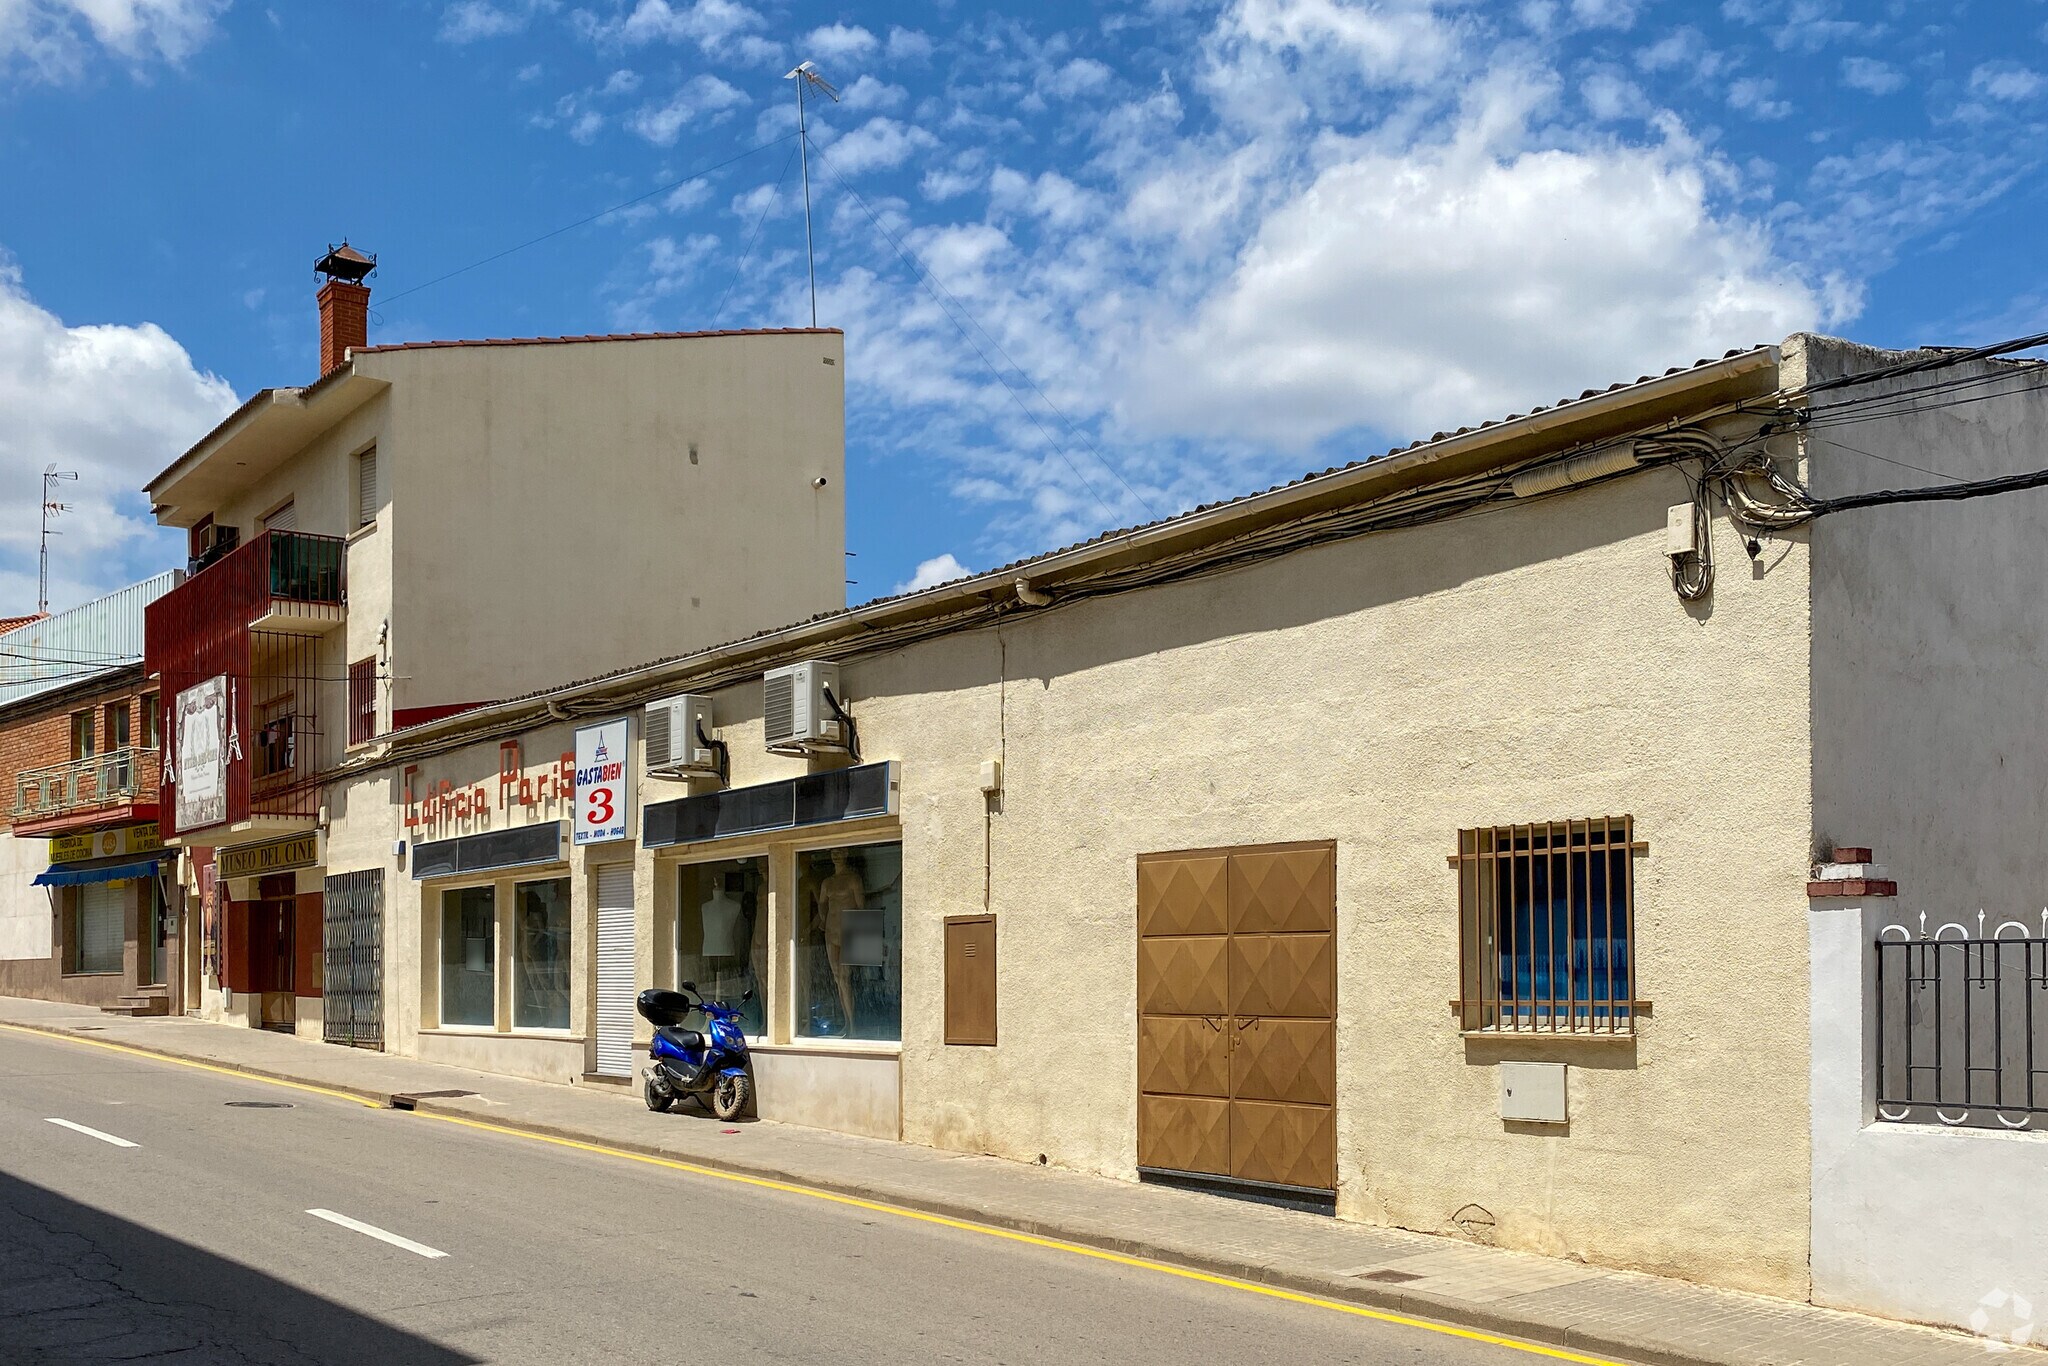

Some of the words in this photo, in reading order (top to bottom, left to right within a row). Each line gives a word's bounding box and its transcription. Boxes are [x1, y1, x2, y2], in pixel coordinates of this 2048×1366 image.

[576, 762, 622, 787] GASTABIEN
[587, 788, 614, 824] 3
[575, 831, 589, 840] TEXTIL
[593, 829, 606, 838] MODA
[610, 826, 625, 836] HOGAR
[77, 837, 83, 846] DE
[137, 841, 143, 850] AL
[50, 850, 69, 862] MUEBLES
[70, 849, 76, 859] DE
[76, 847, 93, 858] COCINA
[220, 850, 256, 873] MUSEO
[260, 846, 280, 867] DEL
[285, 839, 316, 863] CINE
